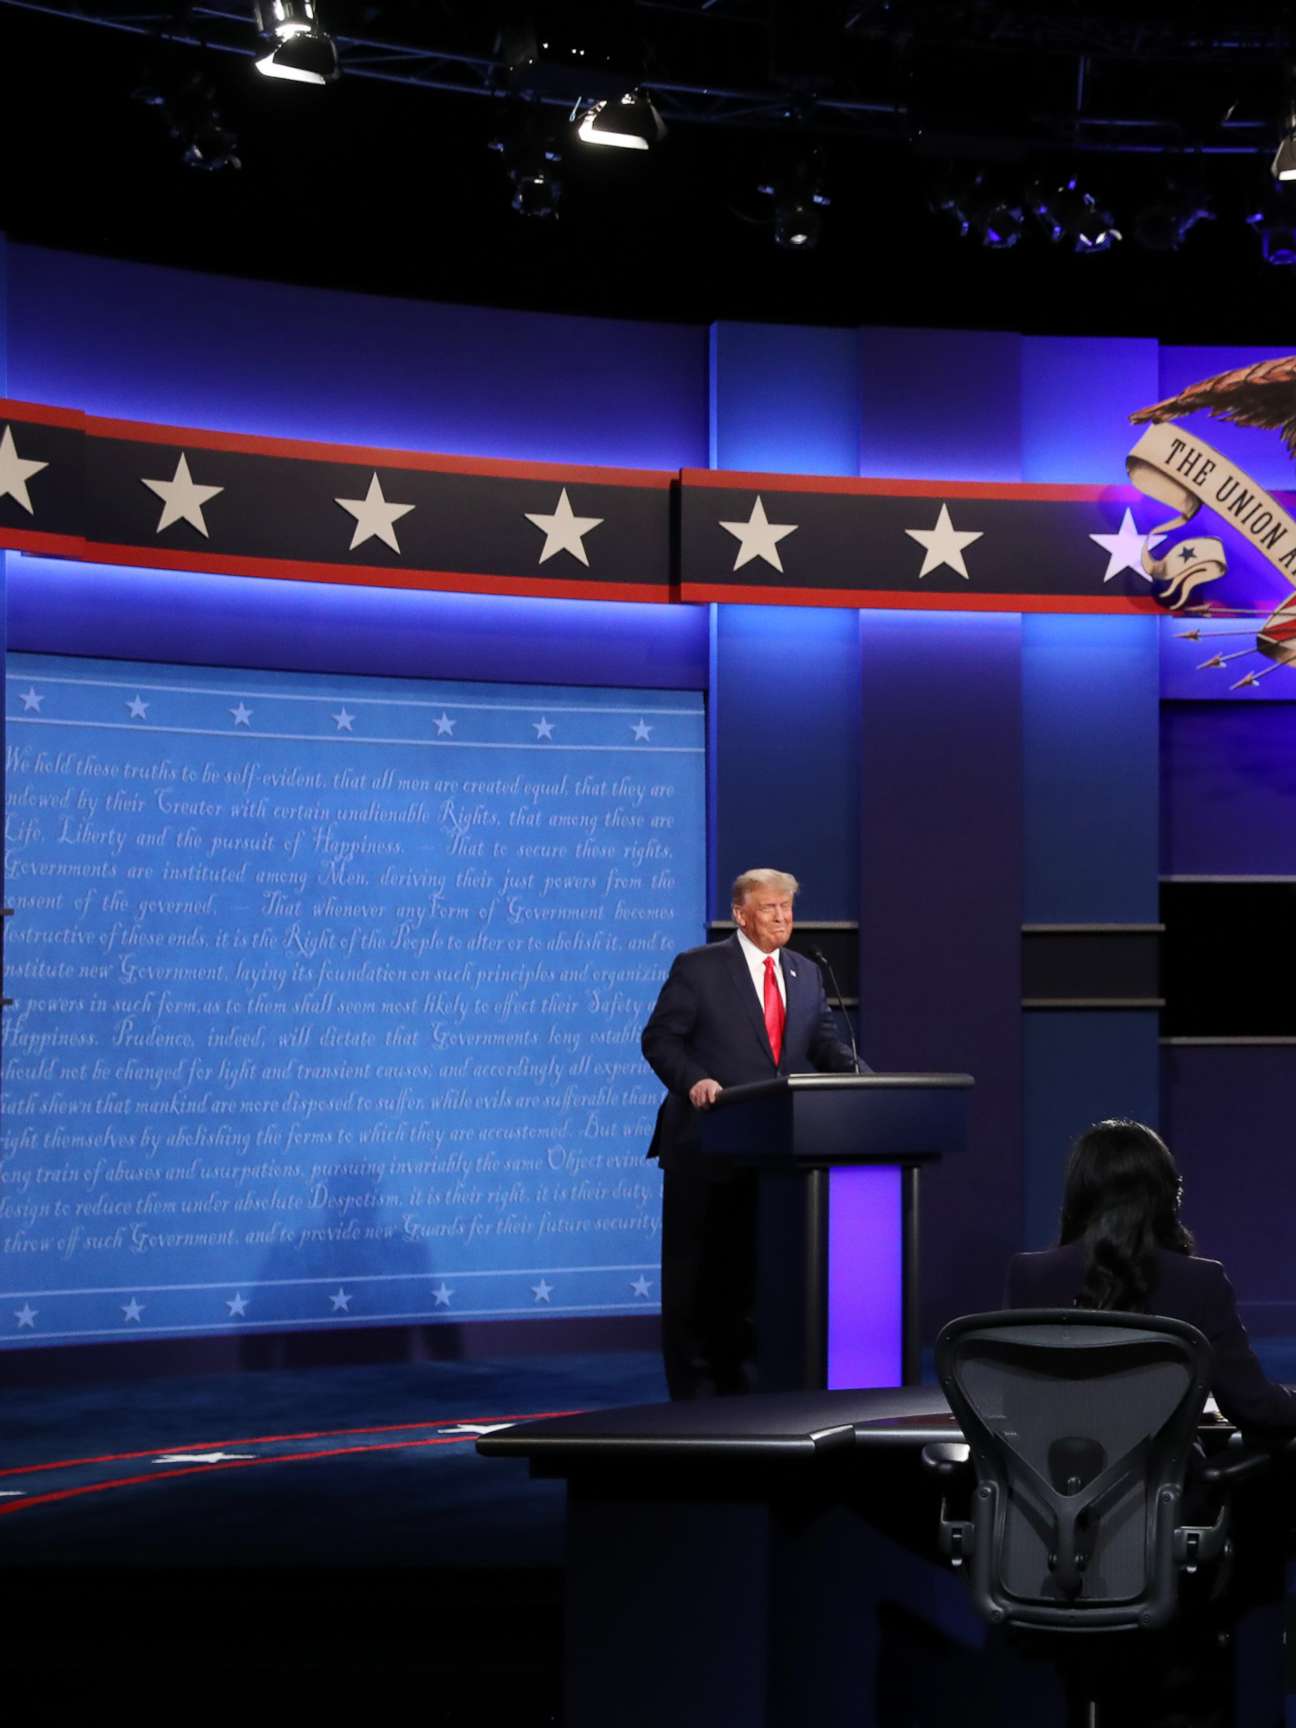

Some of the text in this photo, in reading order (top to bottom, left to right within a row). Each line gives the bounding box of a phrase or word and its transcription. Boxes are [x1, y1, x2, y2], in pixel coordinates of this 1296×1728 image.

[1165, 438, 1217, 487] THE
[1215, 475, 1289, 550] UNION
[5, 744, 33, 773] We
[34, 751, 77, 774] hold
[76, 754, 120, 778] these
[123, 759, 178, 781] truths
[181, 764, 198, 782] to
[201, 761, 221, 784] be
[333, 767, 368, 790] that
[371, 768, 397, 790] all
[398, 777, 430, 792] men
[434, 779, 459, 793] are
[463, 774, 525, 795] created
[574, 774, 610, 797] that
[611, 775, 646, 807] they
[650, 783, 675, 798] are
[4, 782, 71, 809] ndowed
[77, 787, 99, 820] by
[105, 789, 146, 813] their
[154, 786, 225, 817] Creator
[231, 797, 269, 819] with
[273, 801, 330, 821] certain
[337, 799, 430, 823] unalienable
[509, 805, 542, 827] that
[548, 814, 598, 836] among
[604, 806, 645, 828] these
[650, 815, 675, 829] are
[57, 814, 127, 855] Liberty
[136, 825, 172, 847] and
[176, 826, 203, 849] the
[206, 832, 275, 858] pursuit
[283, 829, 306, 862] of
[445, 833, 485, 857] That
[493, 841, 508, 857] to
[516, 844, 568, 858] secure
[575, 837, 617, 859] these
[4, 845, 117, 880] Governments
[126, 865, 154, 880] are
[163, 861, 250, 883] instituted
[255, 871, 308, 893] among
[380, 865, 446, 898] deriving
[456, 866, 494, 889] their
[497, 869, 535, 897] just
[543, 875, 597, 897] powers
[604, 867, 642, 897] from
[651, 867, 676, 890] the
[74, 887, 97, 921] of
[102, 889, 129, 912] the
[261, 889, 302, 917] That
[313, 895, 386, 918] whenever
[396, 905, 426, 930] any
[428, 890, 469, 920] Form
[478, 897, 500, 931] of
[504, 895, 604, 925] Government
[614, 899, 675, 921] becomes
[99, 922, 122, 953] of
[121, 923, 164, 947] these
[215, 928, 230, 949] it
[233, 929, 249, 948] is
[251, 927, 278, 950] the
[282, 920, 336, 959] Right
[340, 927, 361, 958] of
[361, 928, 386, 950] the
[390, 922, 444, 958] People
[447, 935, 463, 951] to
[466, 928, 505, 952] alter
[507, 938, 525, 951] or
[527, 935, 543, 952] to
[546, 930, 605, 952] abolish
[628, 930, 661, 951] and
[659, 935, 676, 952] to
[4, 958, 74, 979] nstitute
[78, 964, 114, 979] new
[235, 960, 287, 992] laying
[292, 962, 314, 982] its
[317, 959, 407, 990] foundation
[410, 969, 433, 982] on
[433, 961, 475, 983] such
[475, 960, 555, 990] principles
[559, 963, 590, 983] and
[20, 997, 85, 1022] powers
[89, 993, 107, 1013] in
[112, 991, 156, 1013] such
[202, 999, 223, 1015] as
[225, 998, 242, 1015] to
[247, 992, 287, 1015] them
[291, 991, 335, 1015] shall
[337, 1000, 376, 1015] seem
[381, 998, 418, 1015] most
[423, 992, 469, 1024] likely
[474, 998, 490, 1015] to
[494, 991, 536, 1023] effect
[541, 992, 579, 1014] their
[586, 988, 645, 1022] Safety
[278, 1023, 314, 1047] will
[319, 1025, 376, 1047] dictate
[385, 1024, 419, 1047] that
[431, 1021, 538, 1051] Governments
[548, 1024, 581, 1053] long
[43, 1124, 137, 1149] themselves
[139, 1126, 162, 1159] by
[166, 1124, 251, 1155] abolishing
[256, 1123, 282, 1145] the
[285, 1122, 333, 1153] forms
[359, 1120, 408, 1143] which
[410, 1120, 446, 1151] they
[582, 1109, 618, 1138] But
[3, 1229, 54, 1253] throw
[57, 1225, 81, 1261] off
[82, 1227, 127, 1250] such
[244, 1221, 281, 1244] and
[279, 1225, 295, 1243] to
[295, 1219, 361, 1251] provide
[364, 1224, 398, 1239] new
[402, 1213, 466, 1241] Guards
[464, 1213, 493, 1246] for
[496, 1213, 535, 1234] their
[537, 1211, 591, 1241] future
